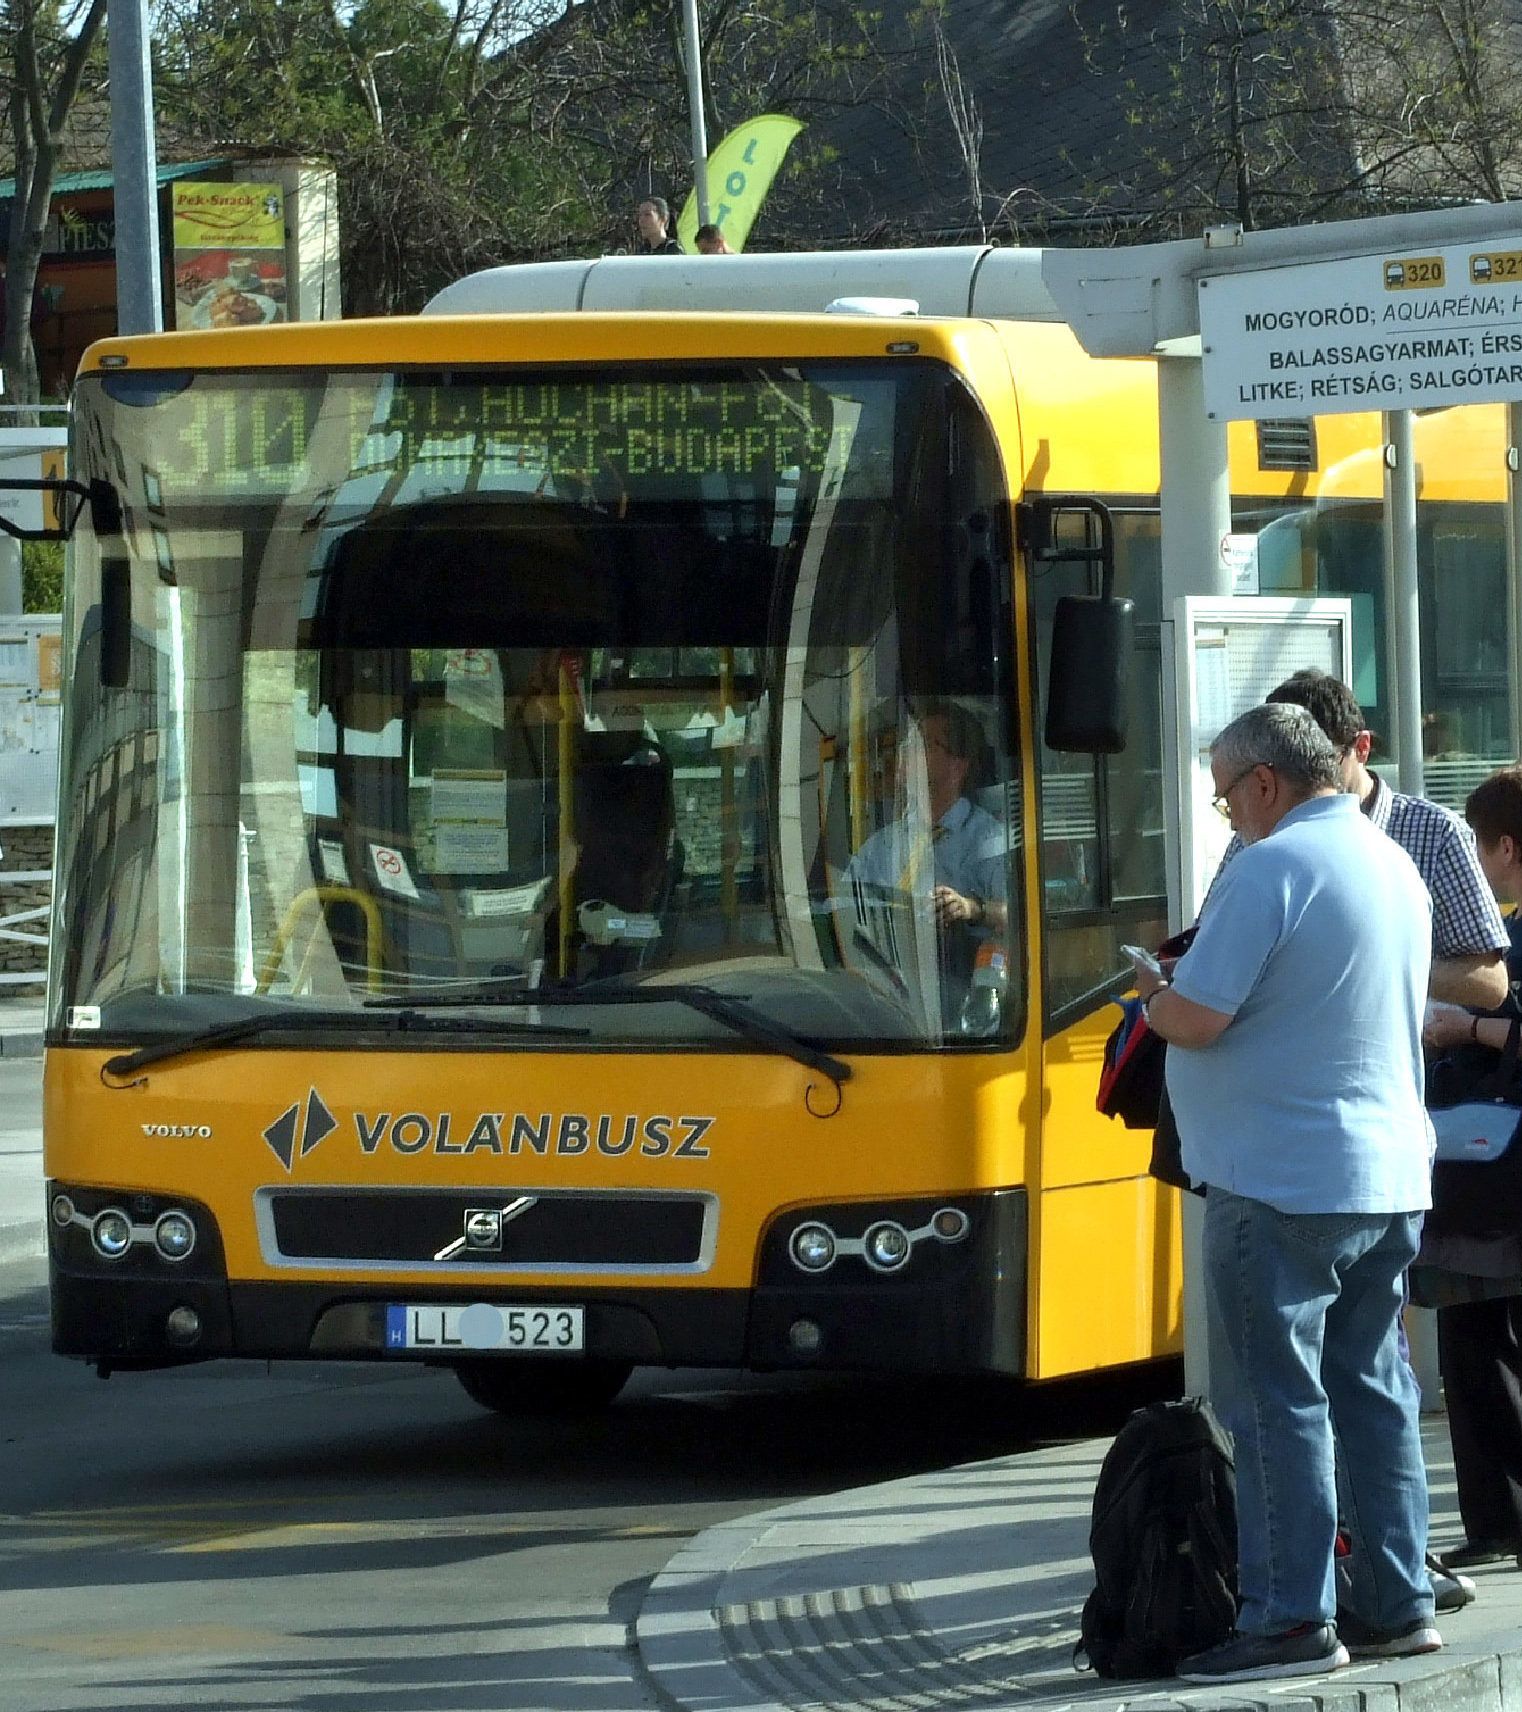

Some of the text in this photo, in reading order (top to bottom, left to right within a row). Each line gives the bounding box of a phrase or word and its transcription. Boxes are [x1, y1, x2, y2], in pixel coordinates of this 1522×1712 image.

[1408, 260, 1442, 283] 320
[1243, 304, 1378, 333] MOGYORÓD;
[1382, 293, 1506, 323] AQUARÉNA;
[1268, 336, 1475, 371] BALASSAGYARMAT;
[1238, 379, 1304, 404] LITKE;
[1310, 370, 1403, 398] RÉTSÁG;
[156, 386, 311, 486] 310
[141, 1123, 212, 1139] VOLVO
[353, 1112, 716, 1158] VOLÁNBUSZ
[508, 1311, 574, 1346] 523
